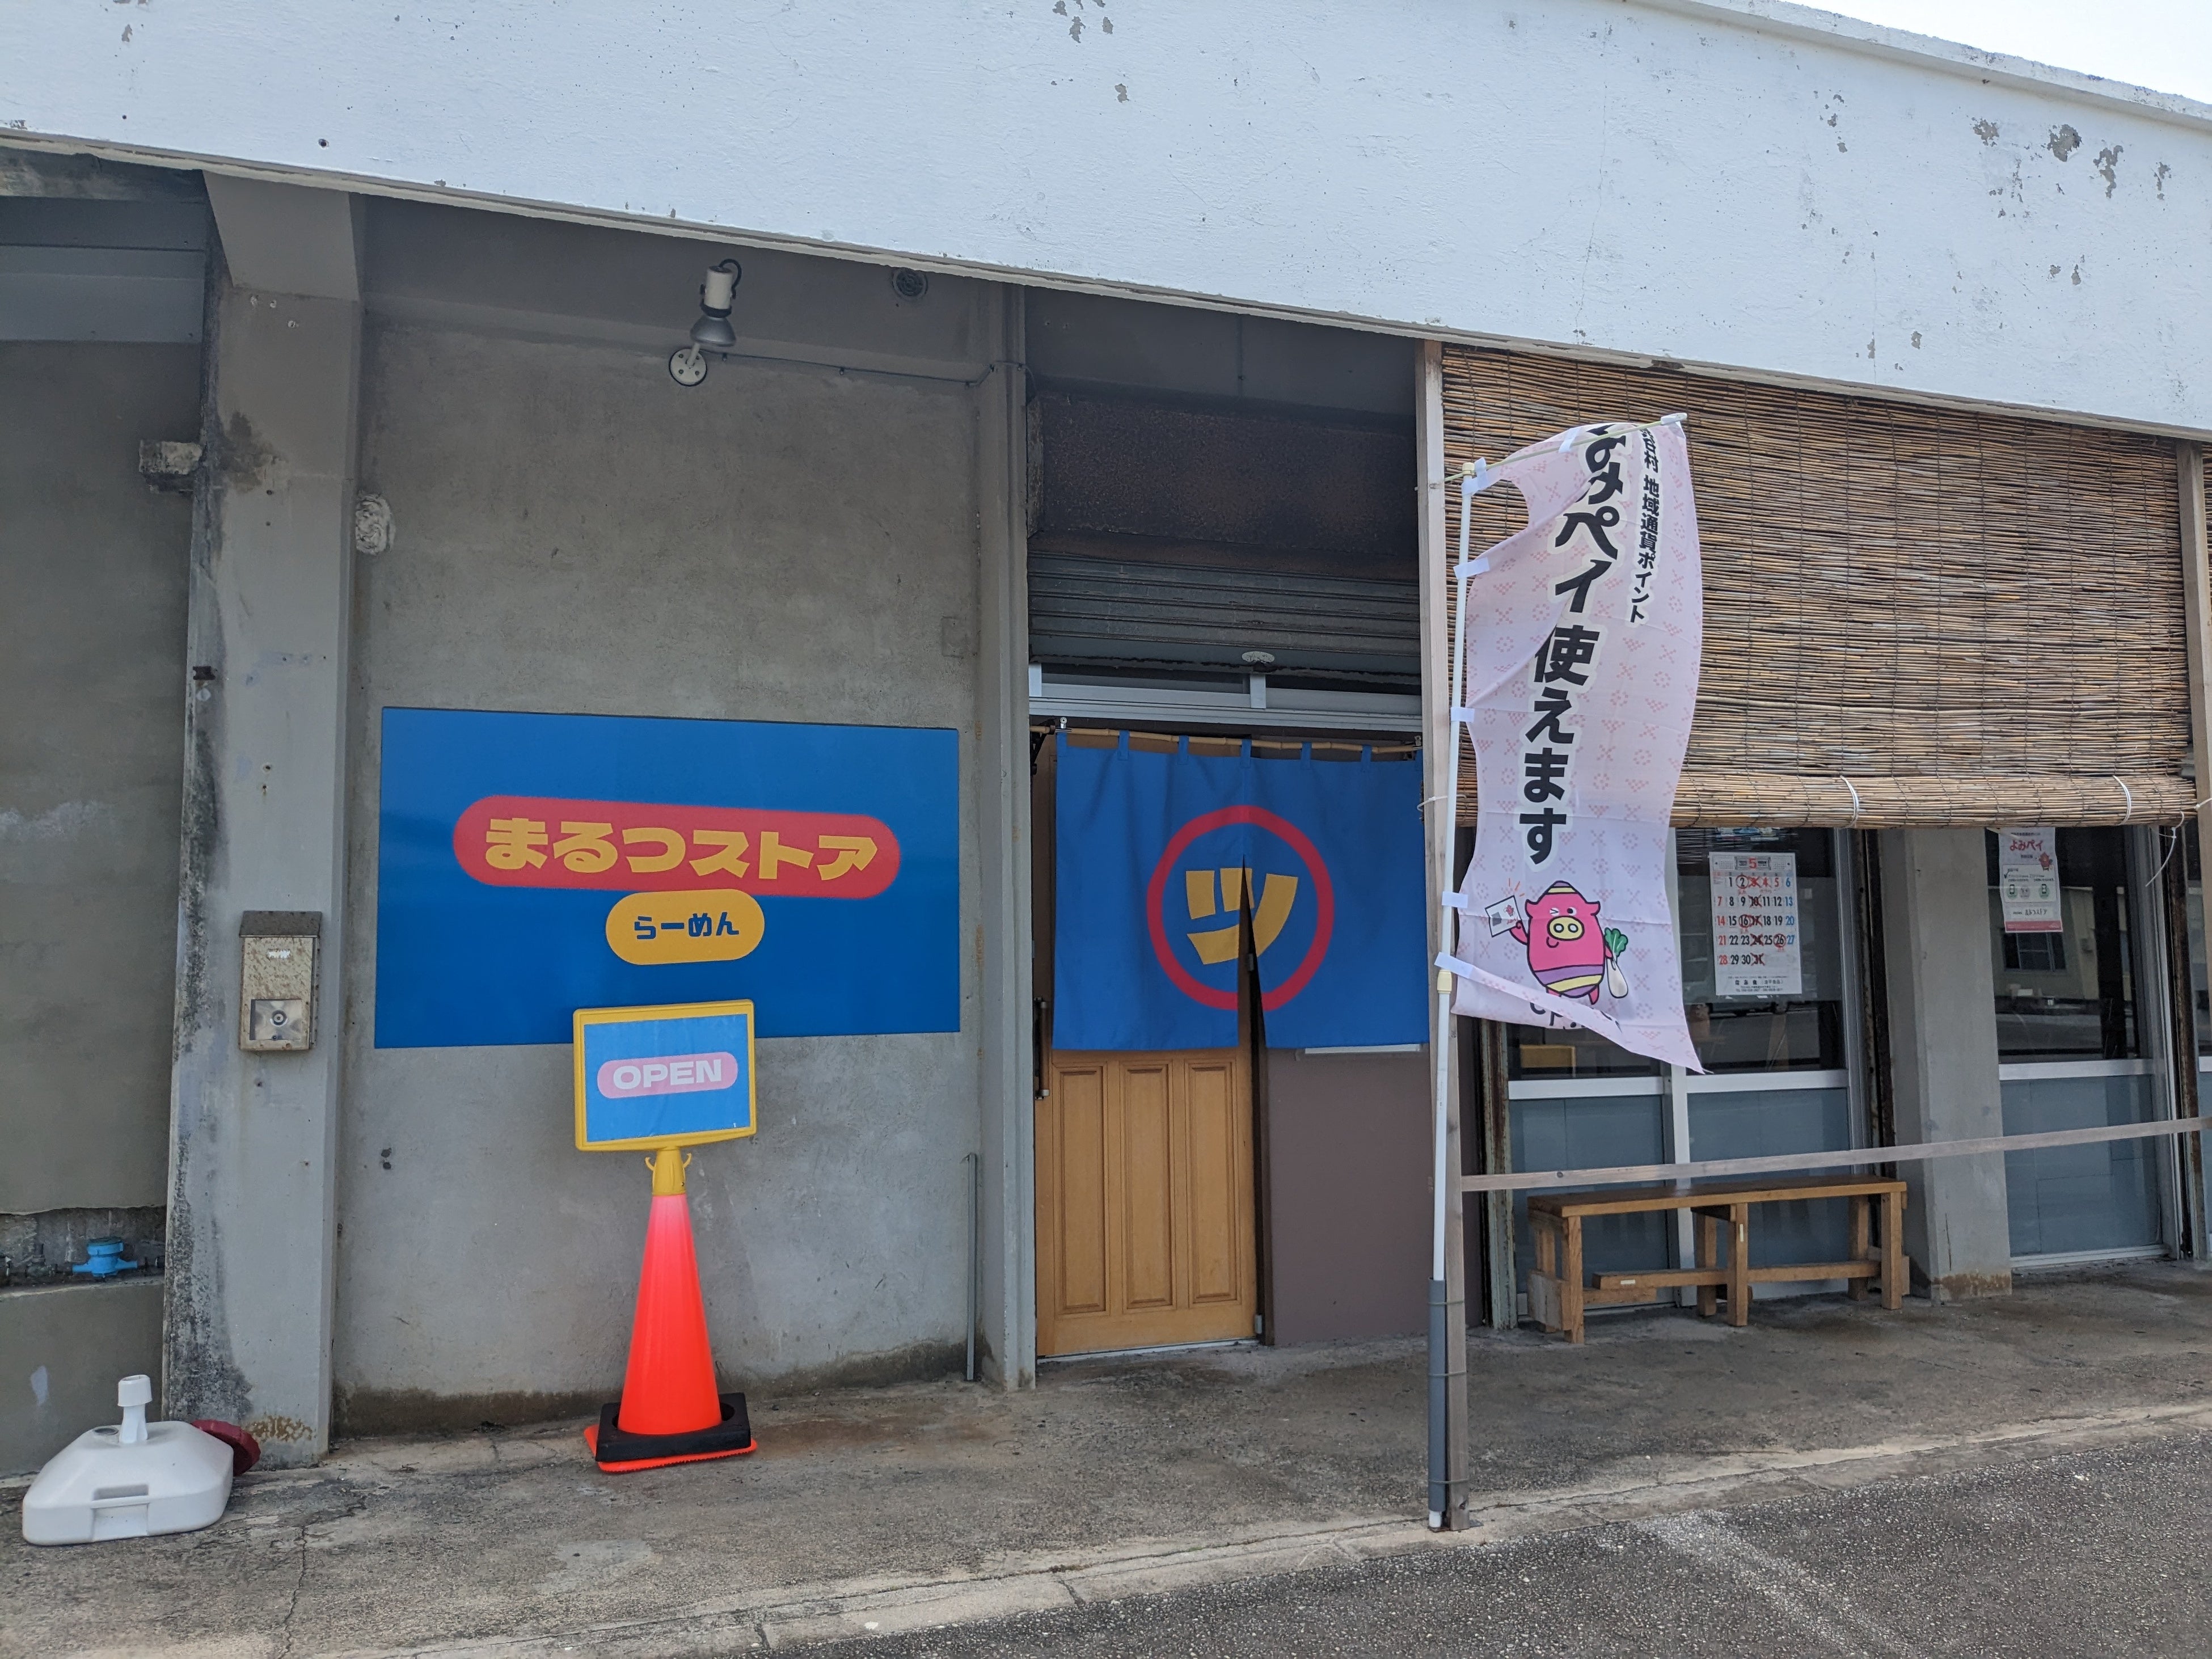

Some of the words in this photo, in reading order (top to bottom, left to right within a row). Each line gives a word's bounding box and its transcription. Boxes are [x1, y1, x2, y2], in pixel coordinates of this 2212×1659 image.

[1630, 474, 1660, 623] 地域通貨ポイント
[485, 817, 879, 881] まるつストア
[2010, 839, 2044, 851] よみペイ
[1749, 858, 1757, 869] 5
[1729, 877, 1733, 887] 1
[1740, 877, 1745, 887] 2
[1774, 877, 1779, 887] 5
[1785, 877, 1791, 887] 6
[1717, 896, 1723, 906] 7
[1729, 896, 1734, 906] 8
[1741, 896, 1746, 906] 9
[1763, 896, 1770, 906] 11
[1774, 896, 1782, 906] 12
[1785, 896, 1793, 906] 13
[634, 910, 741, 940] らーめん
[1717, 915, 1725, 926] 14
[1729, 915, 1737, 926] 15
[1741, 915, 1749, 926] 16
[1763, 915, 1771, 926] 18
[1774, 915, 1783, 926] 19
[1785, 915, 1795, 926] 20
[1719, 935, 1726, 945] 21
[1729, 935, 1738, 945] 22
[1741, 935, 1750, 945] 23
[1764, 935, 1772, 945] 25
[1775, 935, 1784, 945] 26
[1787, 935, 1795, 945] 27
[1719, 955, 1728, 965] 28
[1730, 955, 1739, 965] 29
[1741, 955, 1751, 965] 30
[613, 1059, 722, 1090] OPEN
